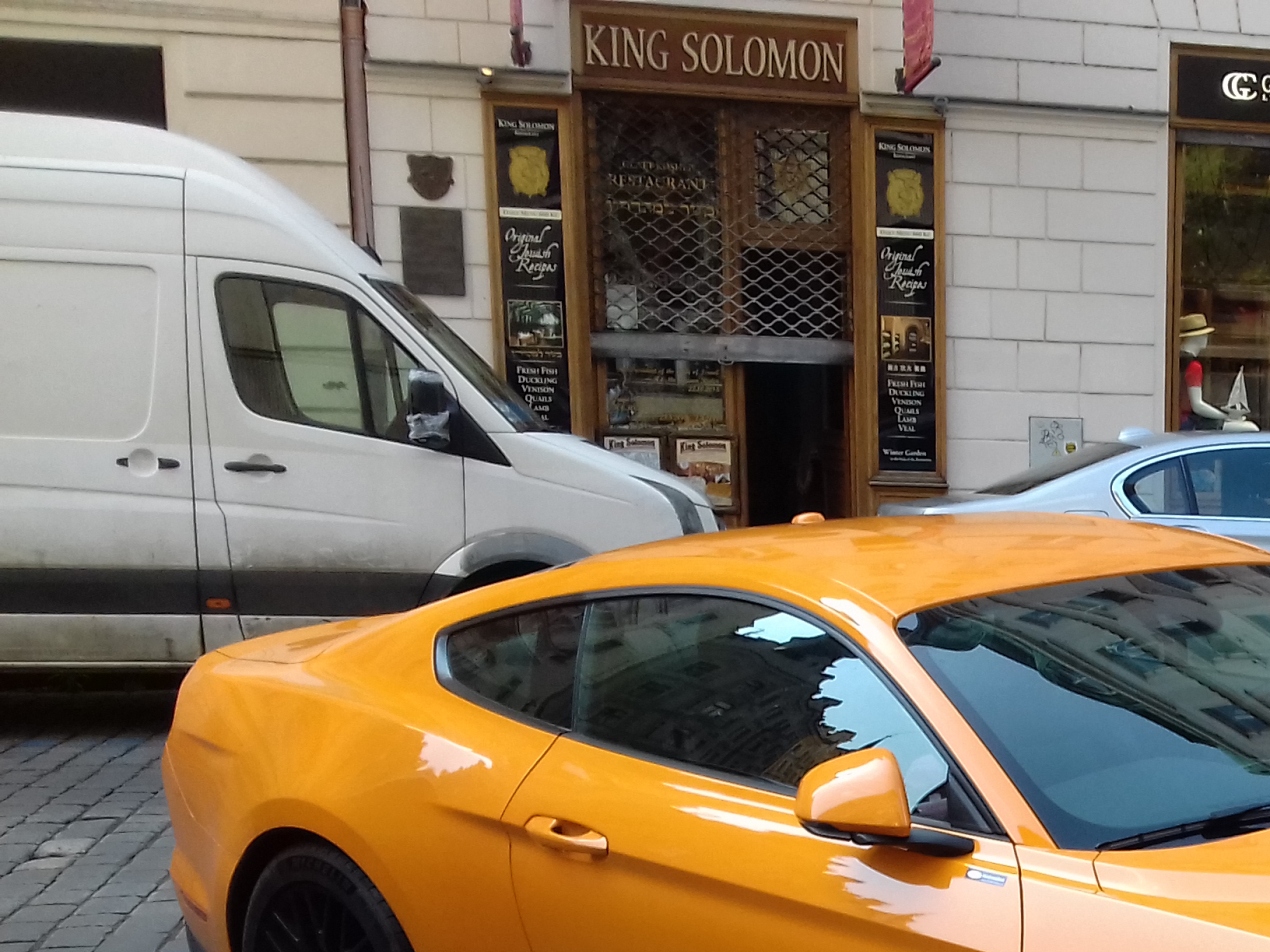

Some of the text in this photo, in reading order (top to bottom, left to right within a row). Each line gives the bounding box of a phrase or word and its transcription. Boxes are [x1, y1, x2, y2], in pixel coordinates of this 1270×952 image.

[583, 23, 845, 84] KING SOLOMON
[497, 118, 555, 131] KING SOLOMON
[878, 141, 931, 153] KING SOLOMON
[505, 225, 551, 254] Original
[880, 244, 923, 271] Original
[515, 257, 558, 281] Recipes
[888, 275, 928, 298] Recipes
[516, 365, 558, 376] FRESH FISH
[517, 375, 558, 385] DUCKLING
[887, 379, 926, 389] FRESH FISH
[521, 384, 555, 394] VENISON
[888, 388, 925, 398] DUCKLING
[525, 393, 552, 404] QUAILS
[891, 397, 922, 407] VENISON
[894, 406, 920, 416] QUAILS
[897, 415, 917, 424] LAMB
[898, 424, 916, 433] VEAL
[680, 440, 727, 455] King Solomon
[882, 448, 927, 458] Winter Garden
